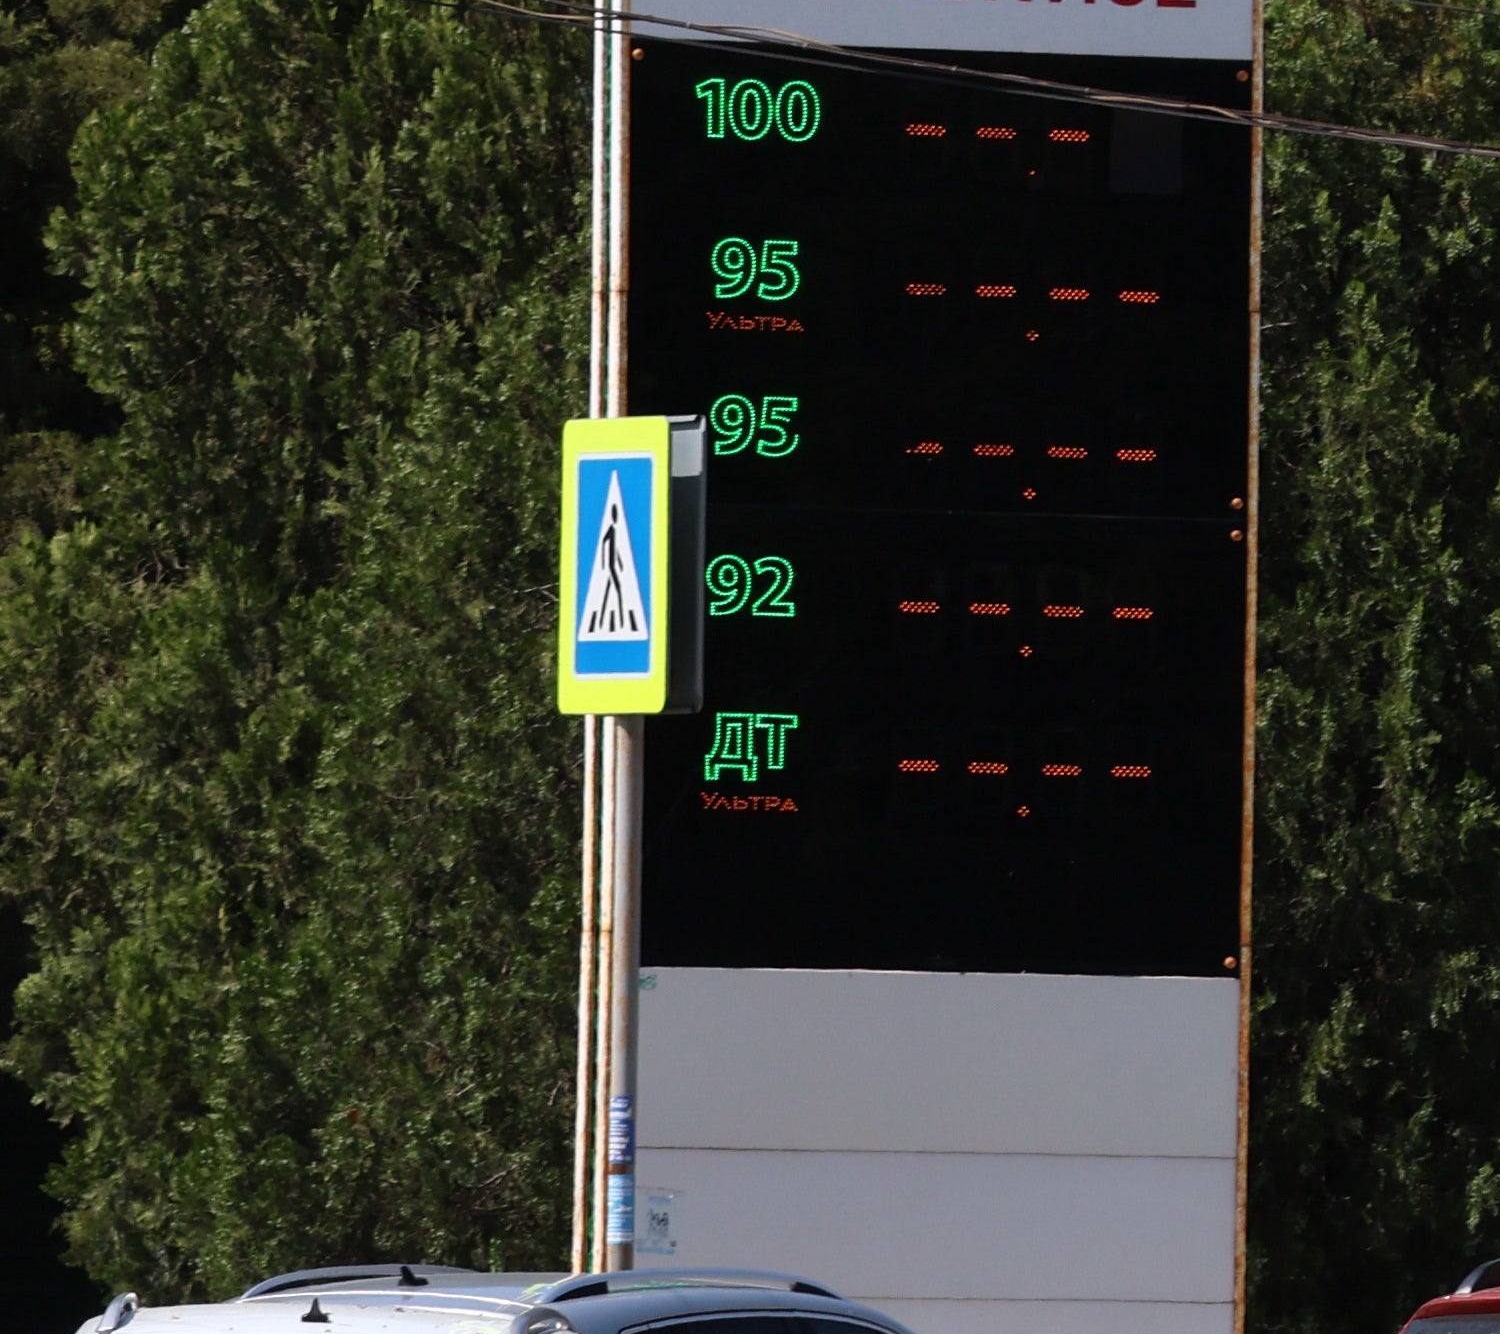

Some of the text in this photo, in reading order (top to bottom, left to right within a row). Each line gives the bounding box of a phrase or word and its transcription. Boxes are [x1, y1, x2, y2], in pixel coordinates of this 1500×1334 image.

[695, 78, 821, 141] 100
[711, 237, 800, 301] 95
[705, 310, 805, 332] УЛЬТРА
[709, 394, 799, 457] 95
[705, 553, 796, 617] 92
[704, 713, 799, 782] ДТ
[700, 791, 799, 813] УЛЬТРА
